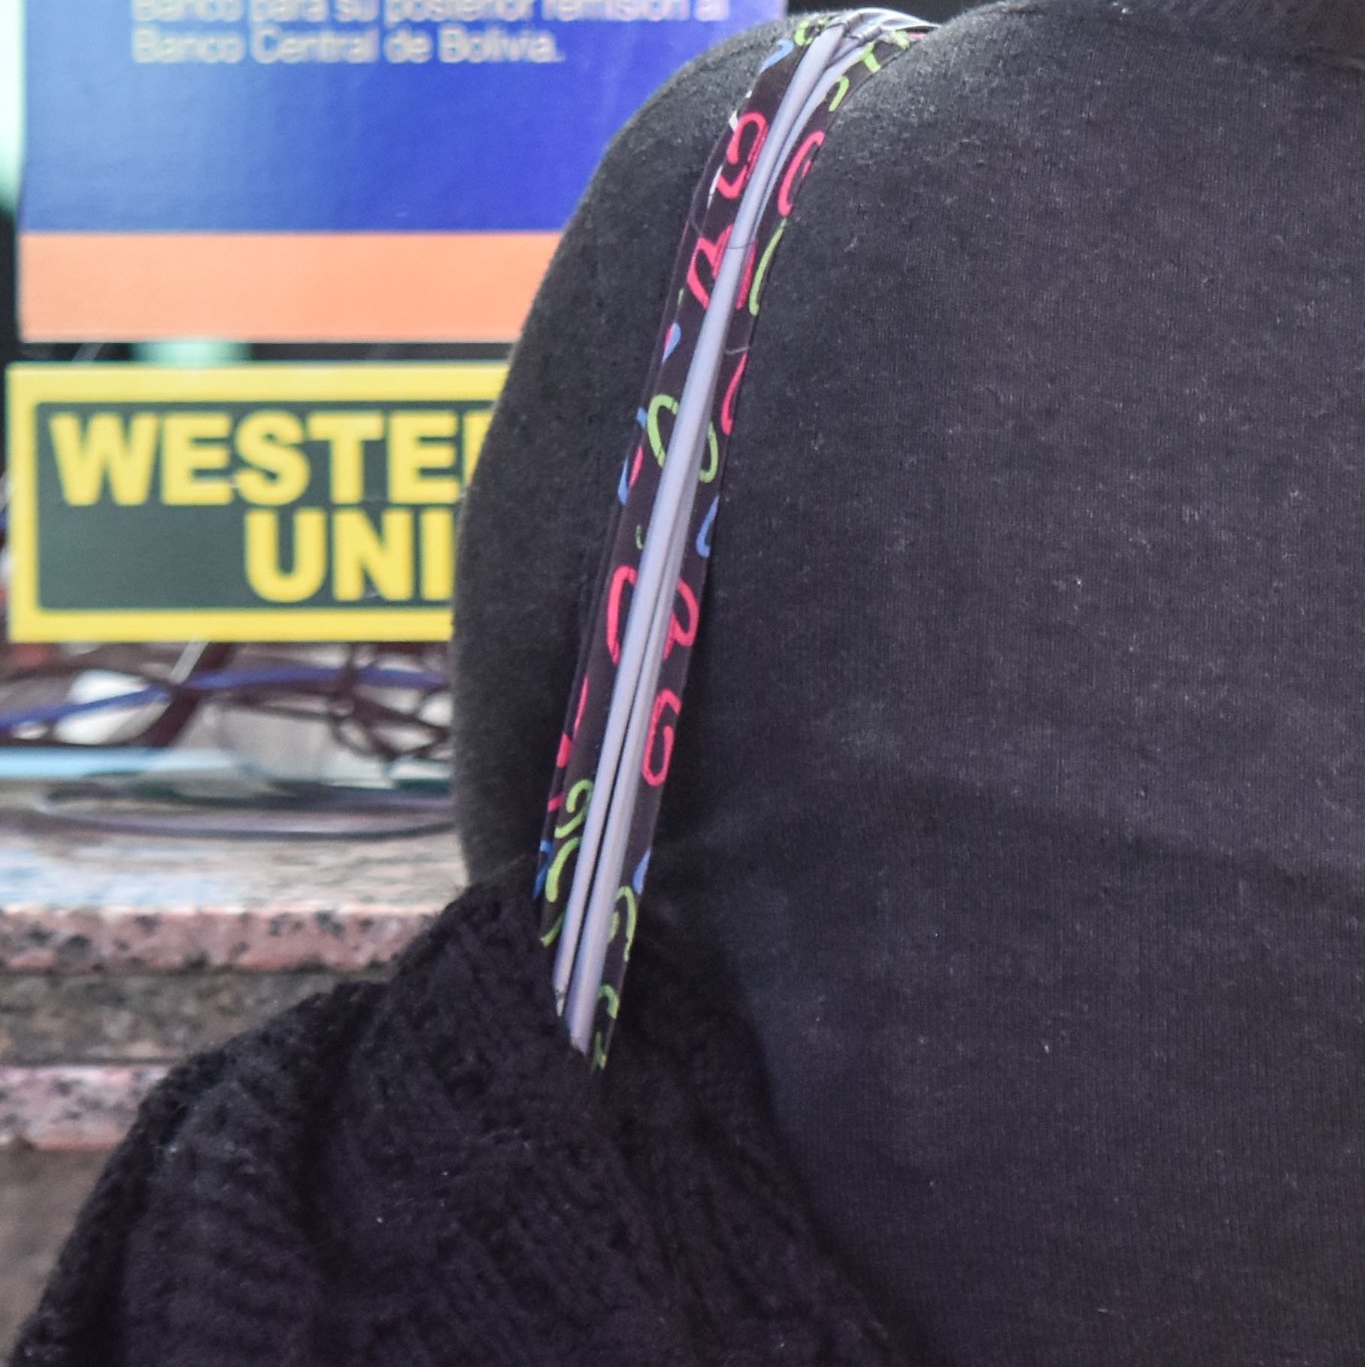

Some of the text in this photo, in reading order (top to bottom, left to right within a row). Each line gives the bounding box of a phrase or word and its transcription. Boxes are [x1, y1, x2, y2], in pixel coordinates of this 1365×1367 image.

[131, 24, 566, 64] Banco Central de Bolivia.
